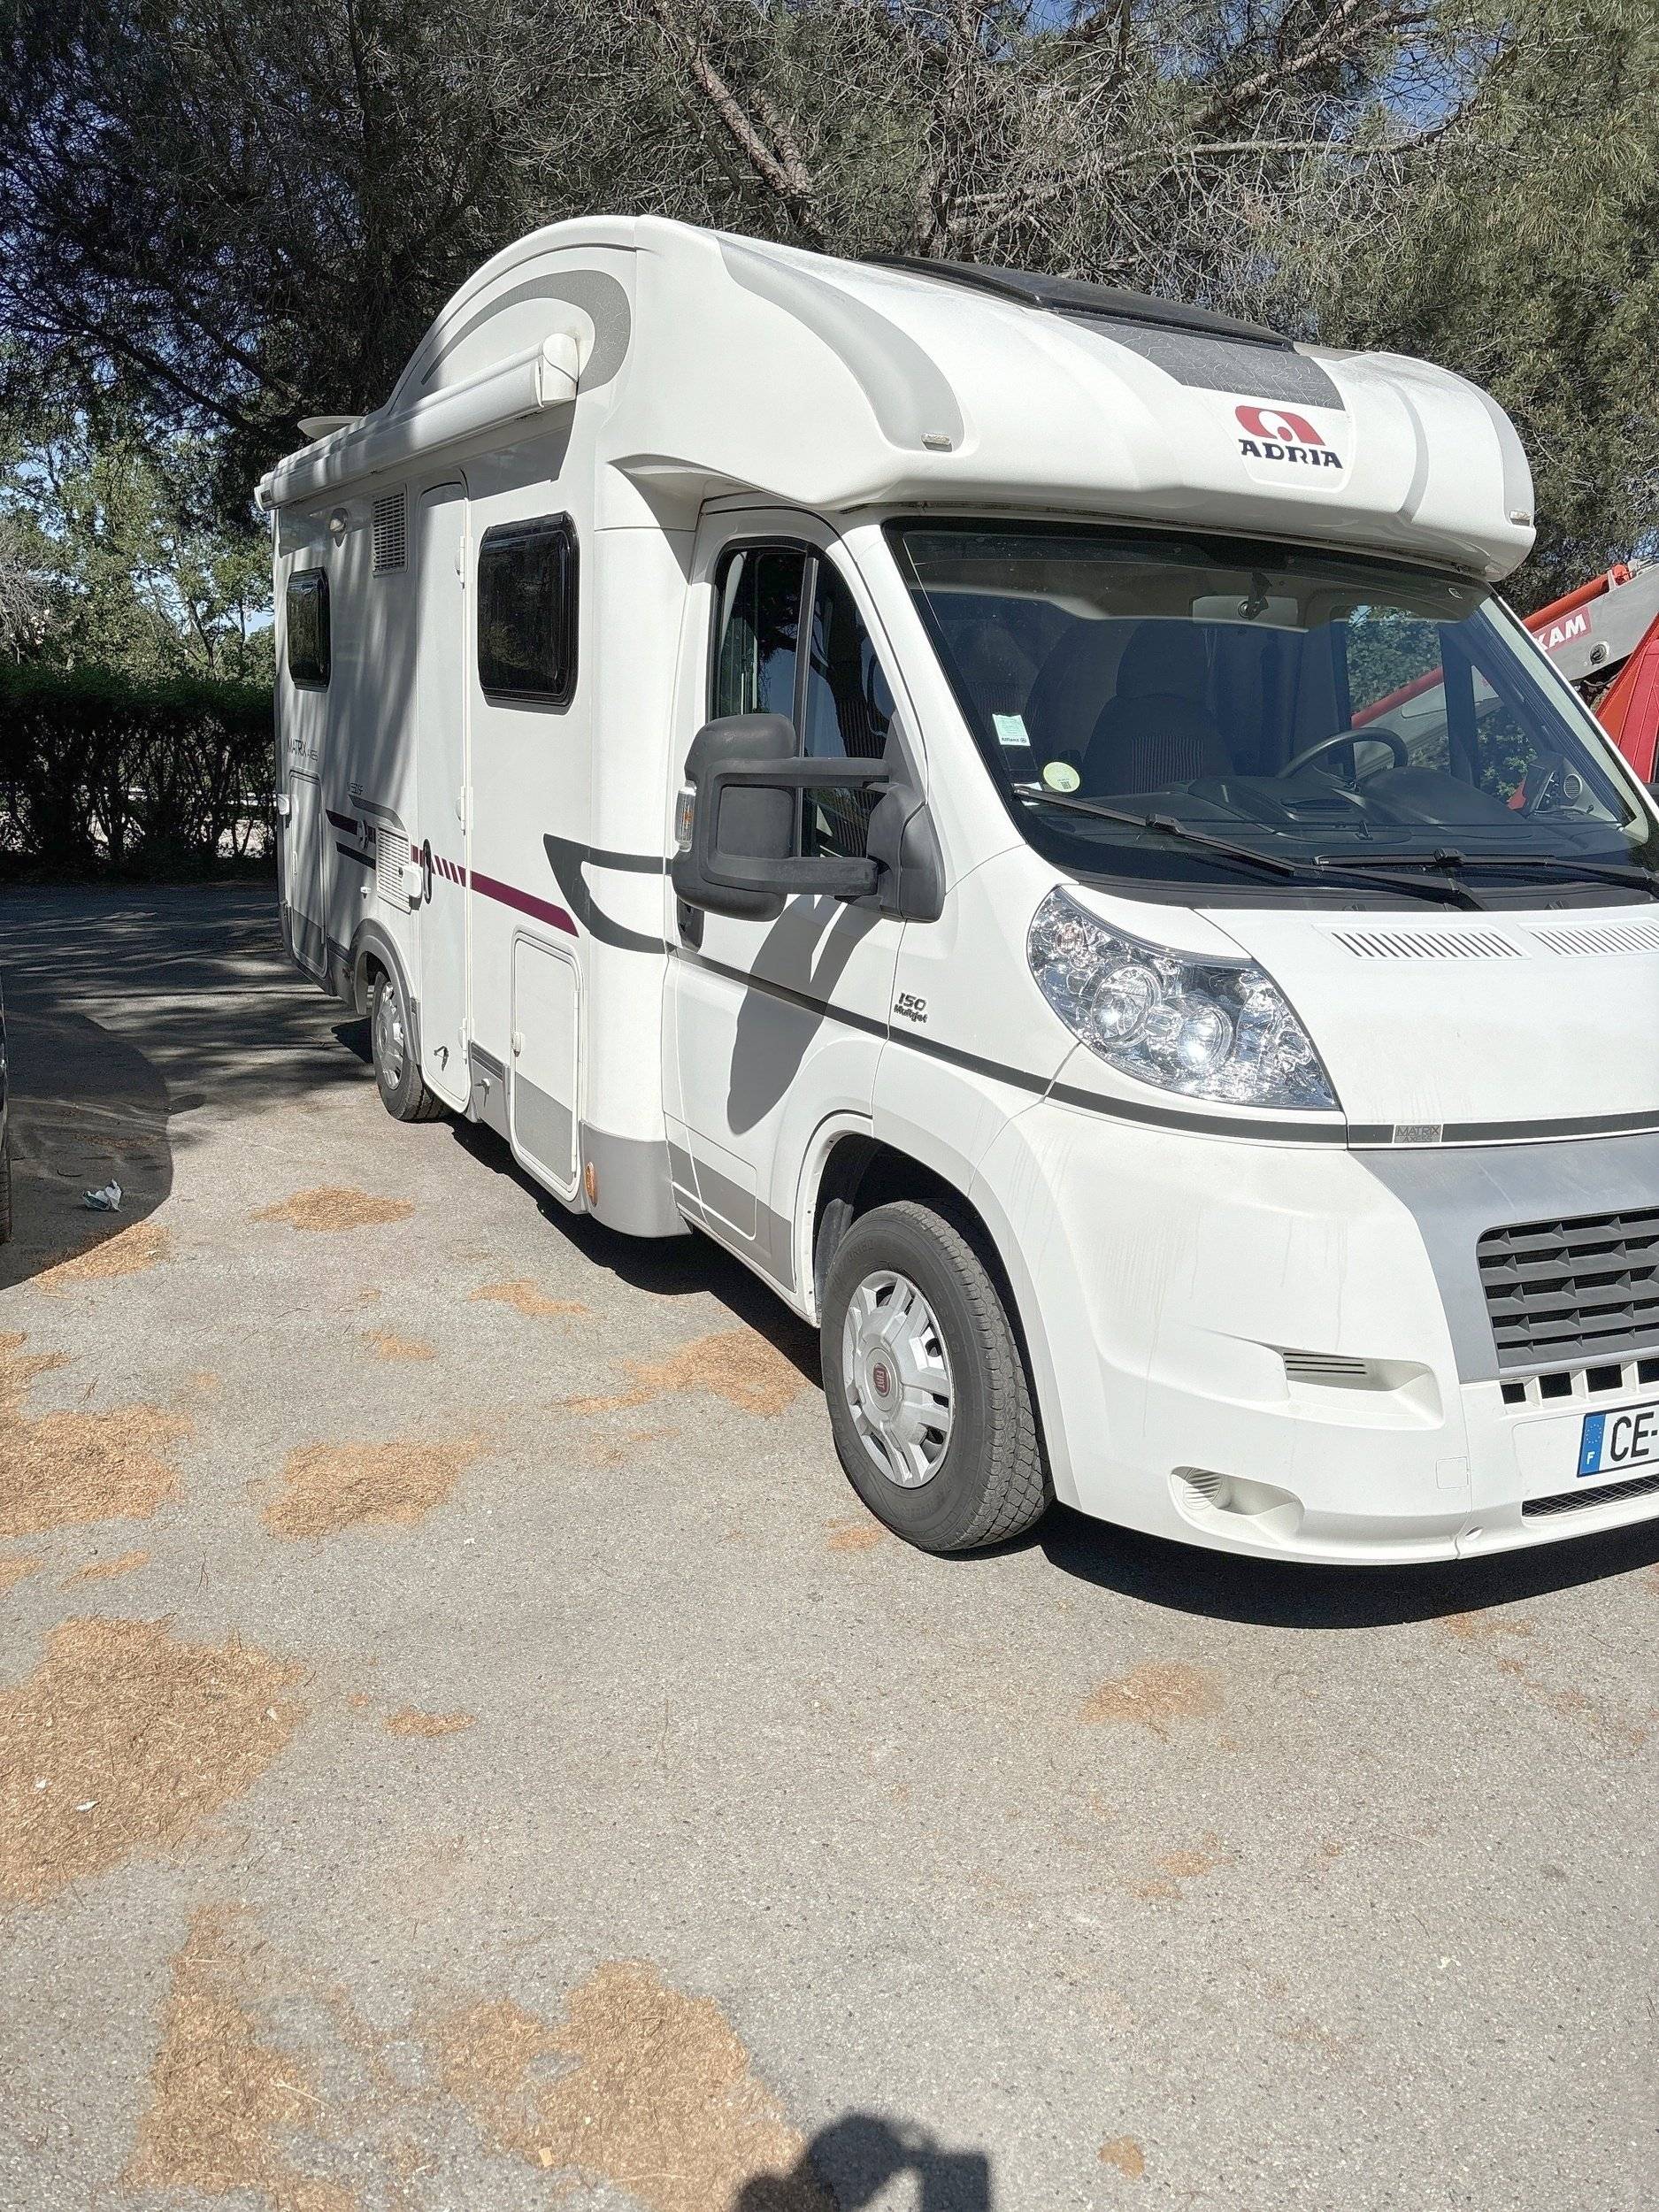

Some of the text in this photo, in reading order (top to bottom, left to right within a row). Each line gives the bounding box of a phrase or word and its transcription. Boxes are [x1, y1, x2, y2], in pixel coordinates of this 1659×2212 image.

[1238, 439, 1343, 469] ADRIA
[899, 993, 926, 1011] 150
[875, 1370, 886, 1389] FIAT
[1586, 1451, 1596, 1465] F
